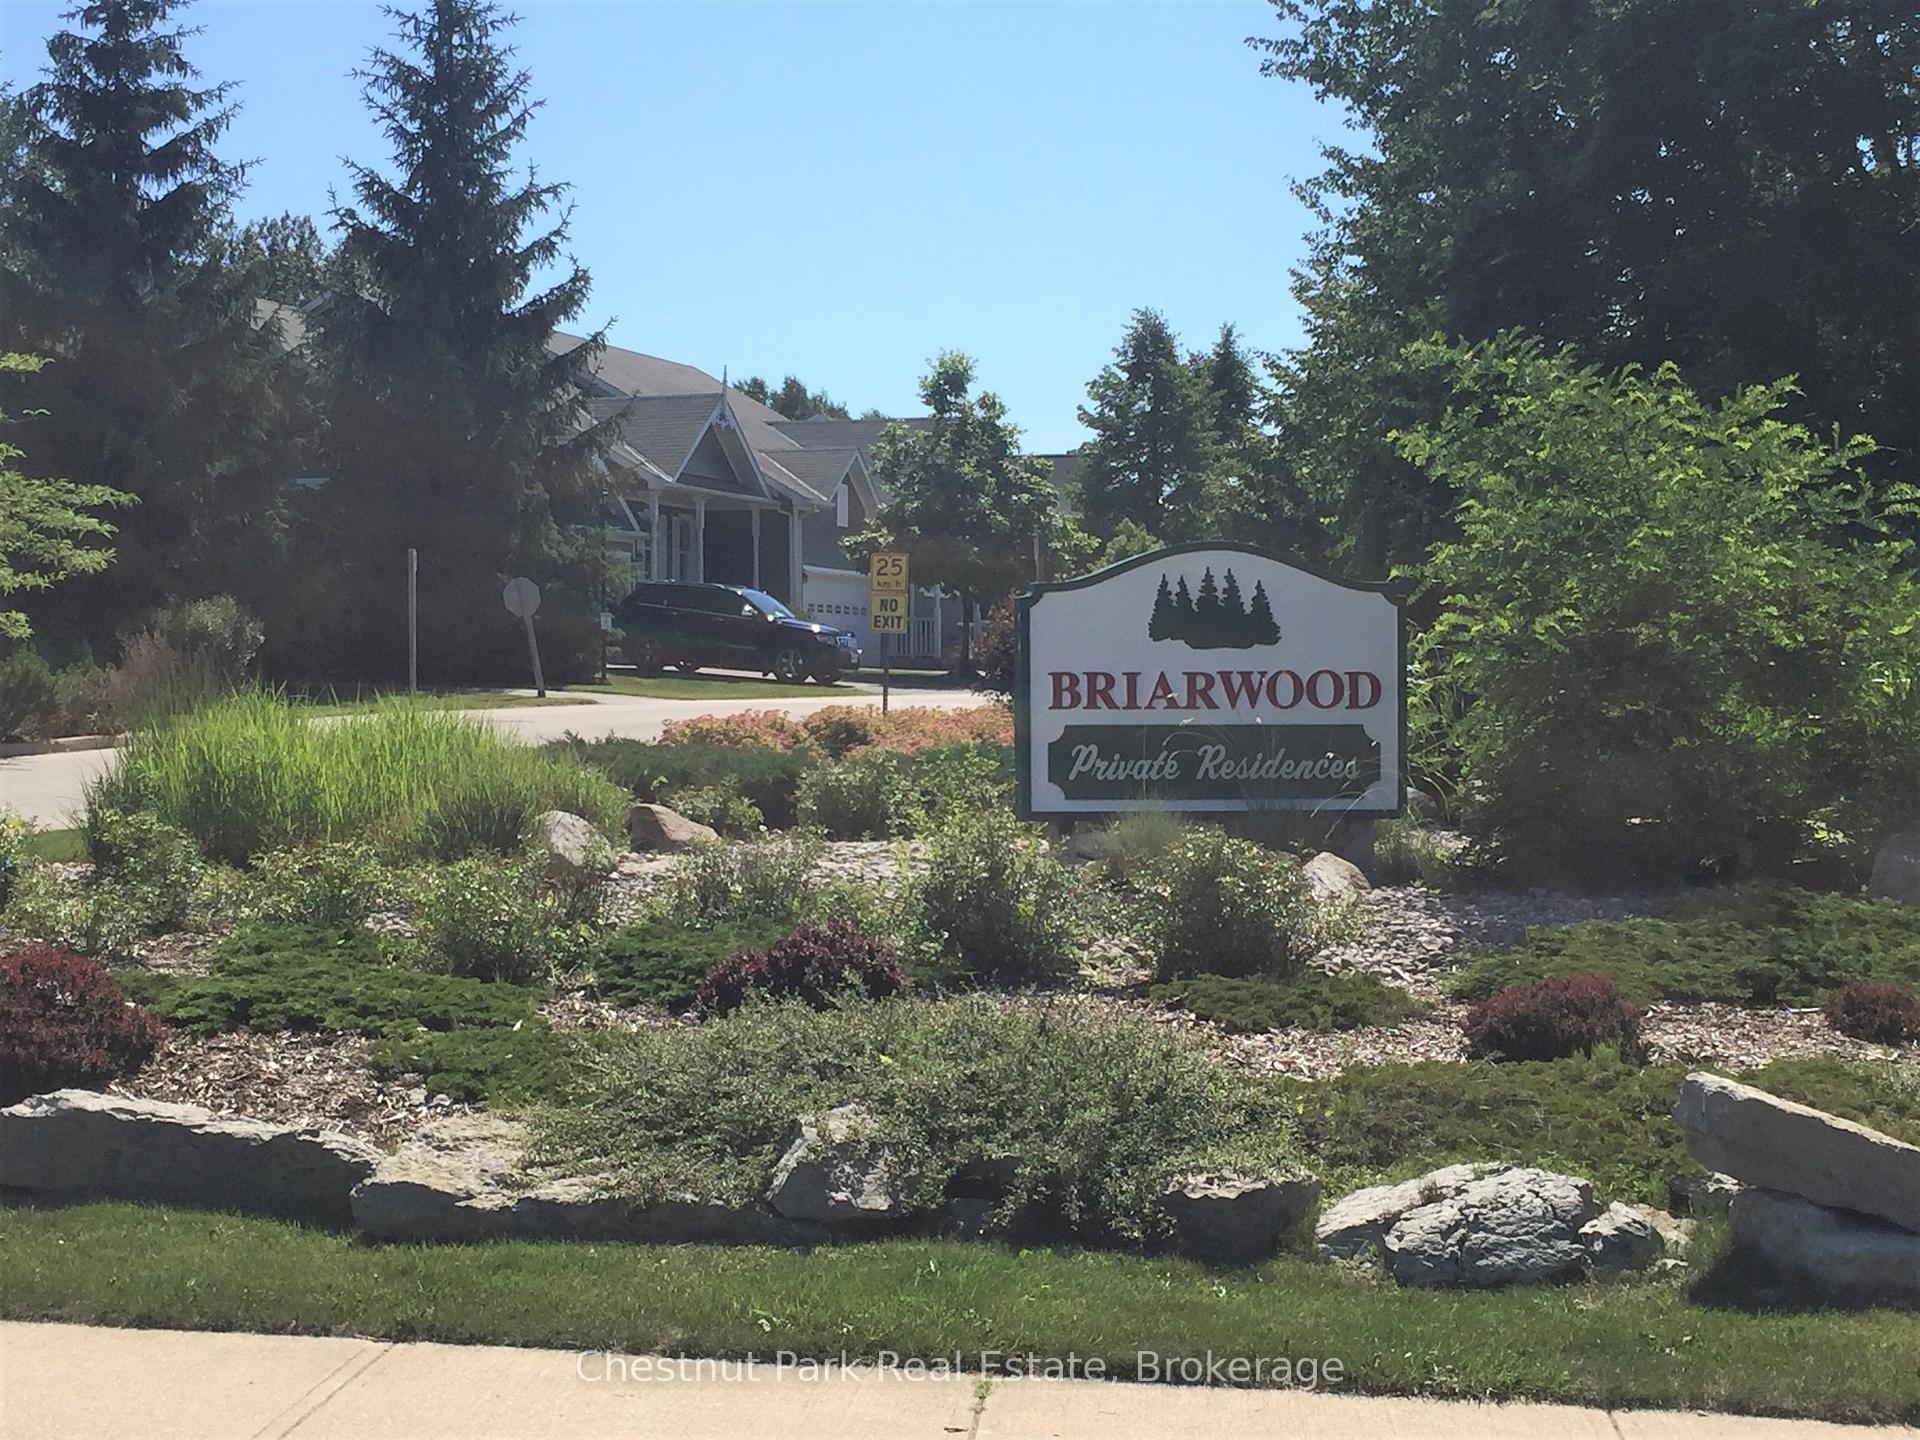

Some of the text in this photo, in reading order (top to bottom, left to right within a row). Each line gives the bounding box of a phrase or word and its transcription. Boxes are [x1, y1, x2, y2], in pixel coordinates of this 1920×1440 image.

[876, 558, 902, 576] 25
[876, 580, 901, 588] kmh
[880, 598, 898, 612] NO
[873, 615, 902, 629] EXIT
[1048, 670, 1382, 710] BRIARWOOD
[1069, 744, 1361, 781] Private Residences
